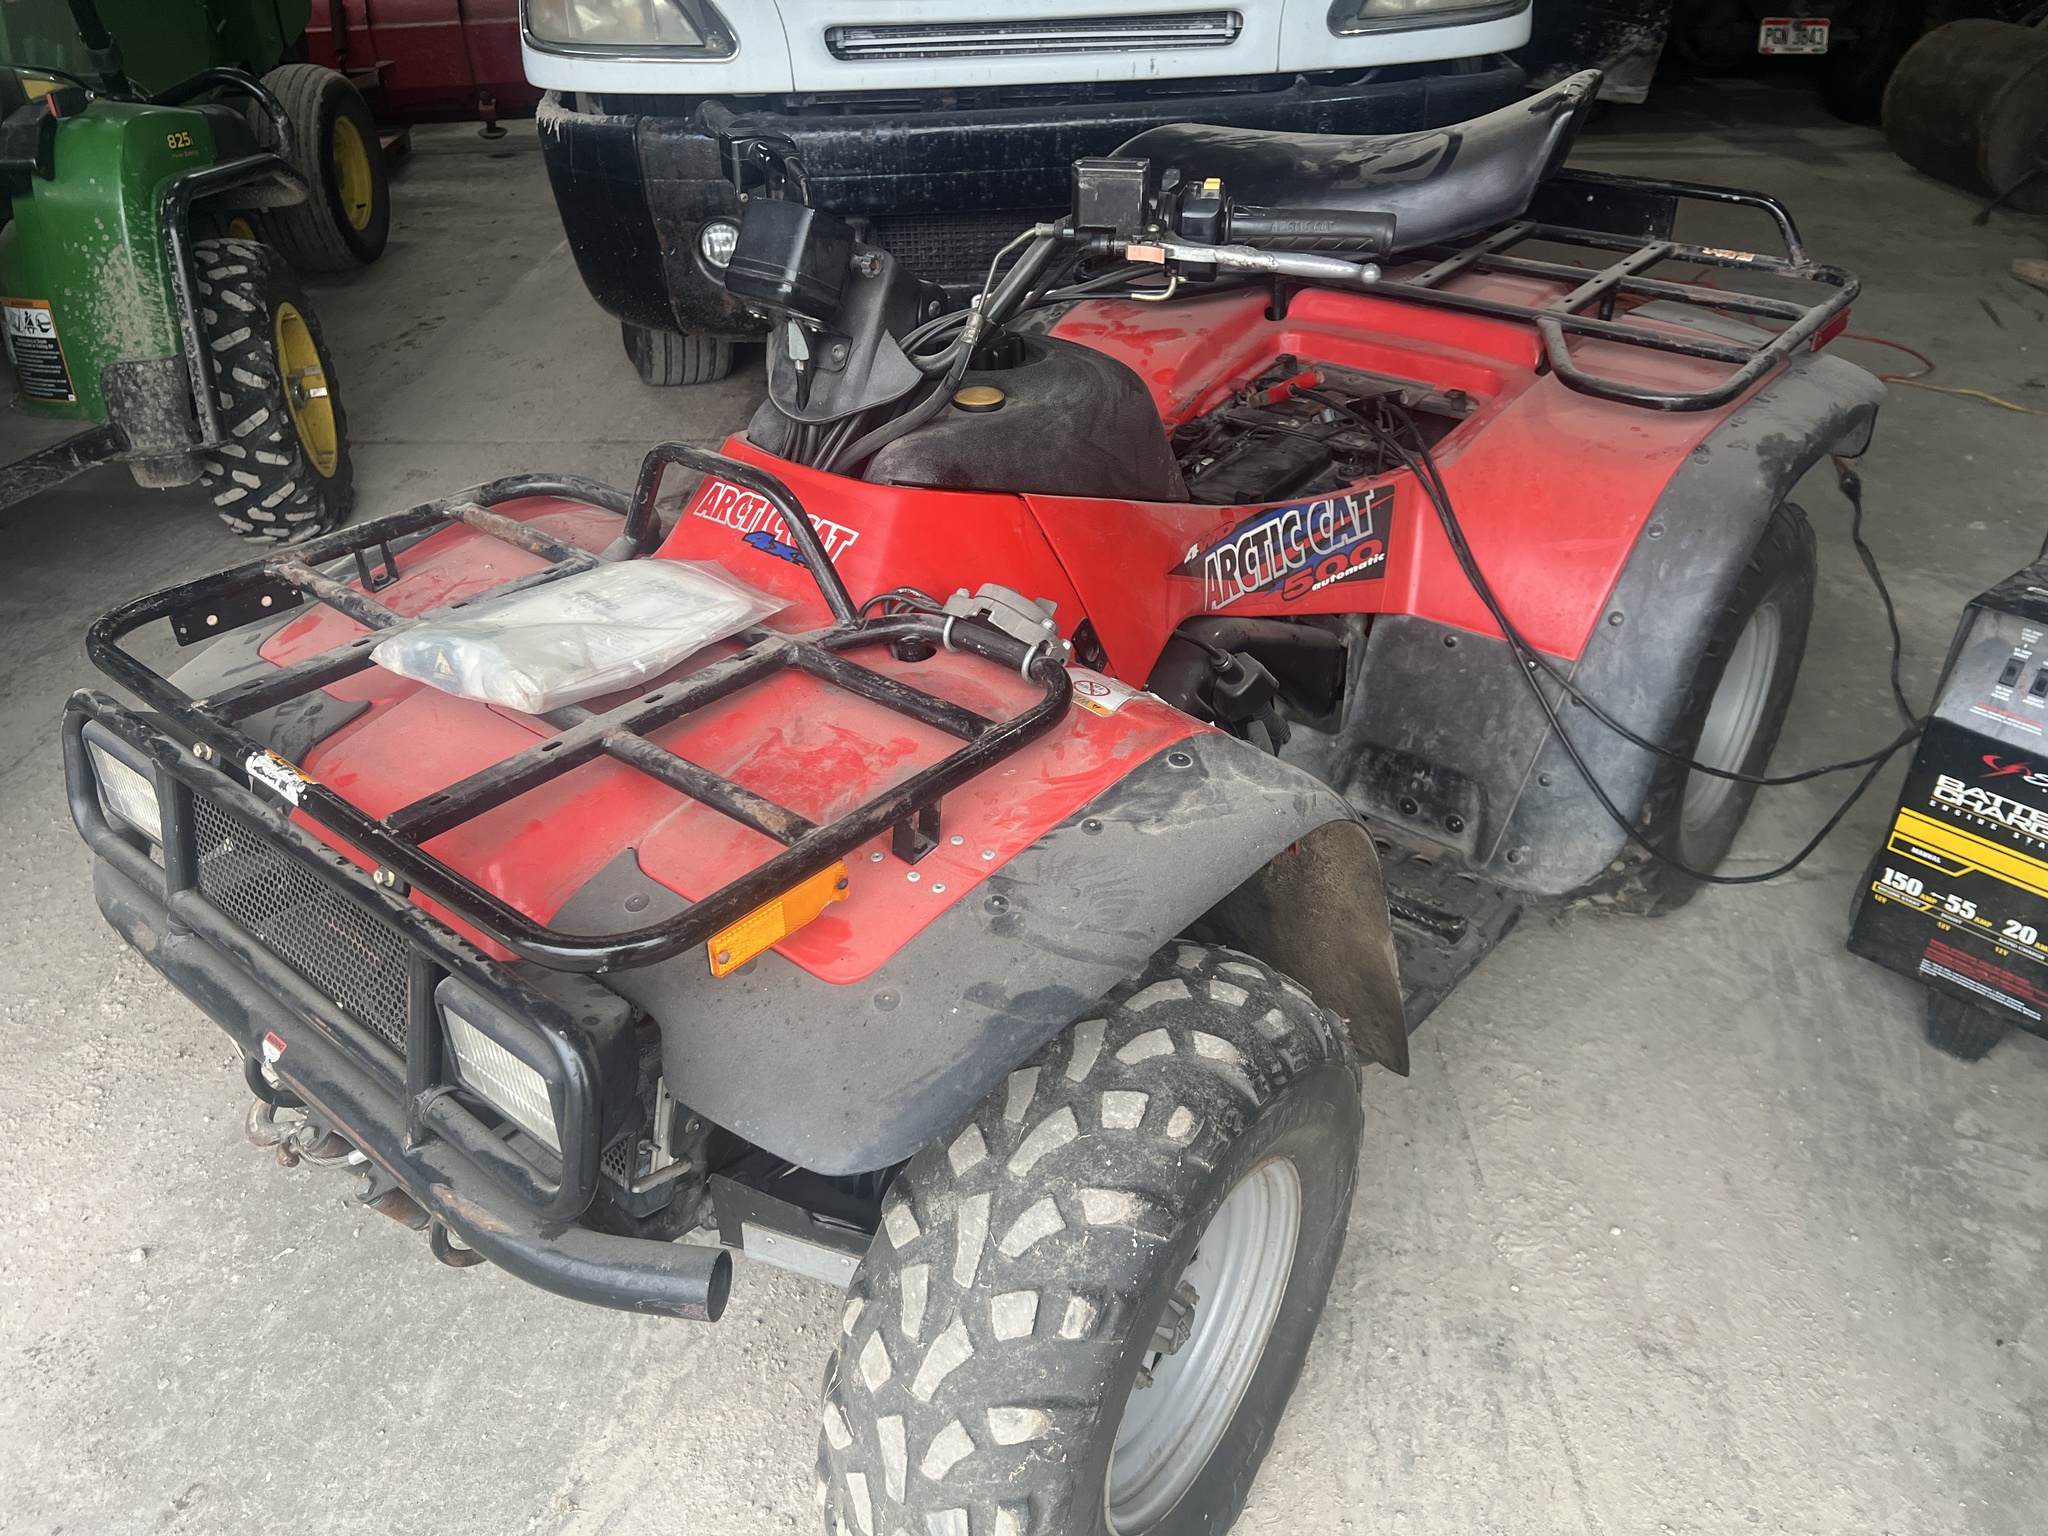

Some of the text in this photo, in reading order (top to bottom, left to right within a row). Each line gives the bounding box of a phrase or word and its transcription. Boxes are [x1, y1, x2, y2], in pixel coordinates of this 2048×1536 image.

[1271, 220, 1333, 233] ARCTIC CAT
[693, 481, 786, 541] ARCTIC
[1183, 520, 1236, 564] 4WD
[1204, 488, 1375, 611] ARCTIC CAT
[1281, 538, 1383, 601] 500
[1311, 551, 1386, 592] automatic
[1929, 800, 1998, 831] ENGINE
[1911, 846, 1942, 864] MANUAL
[1874, 893, 1888, 904] 12V
[1881, 867, 1924, 897] 150
[1920, 893, 1938, 904] AMP
[1944, 893, 1978, 920] 55
[1974, 916, 1993, 928] AMP
[2002, 919, 2038, 945] 20
[1937, 921, 1951, 932] 12V
[1941, 912, 1963, 925] BOOST
[1995, 946, 2009, 957] 12V
[1999, 937, 2046, 960] RAPID CHARGE
